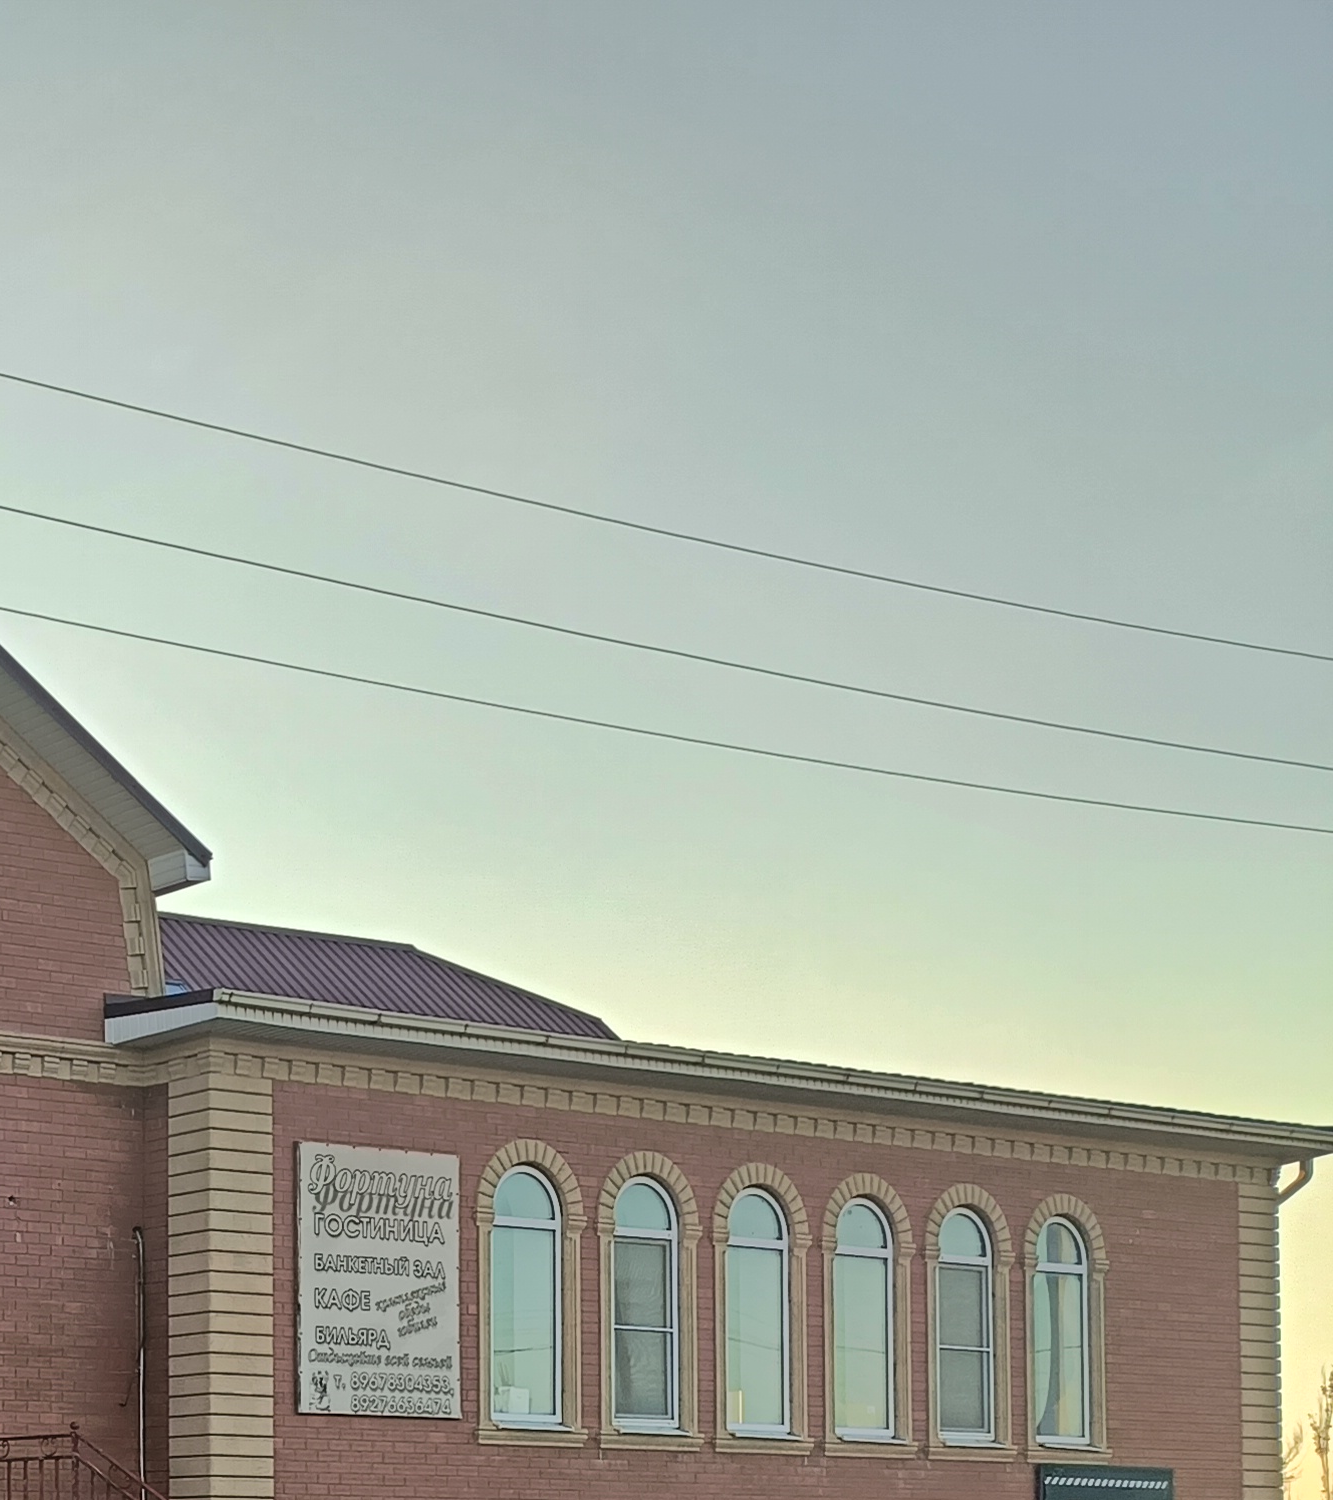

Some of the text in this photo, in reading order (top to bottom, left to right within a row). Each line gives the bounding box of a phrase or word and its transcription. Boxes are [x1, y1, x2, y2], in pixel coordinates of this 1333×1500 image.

[308, 1153, 453, 1208] Фортуна
[313, 1211, 445, 1247] ГОСТИНИЦА
[313, 1253, 446, 1280] БАНКЕТНЫЙ ЗАЛ
[314, 1287, 371, 1312] КАФЕ
[315, 1325, 391, 1350] БИЛЬЯРД
[350, 1394, 452, 1415] 89276636474
